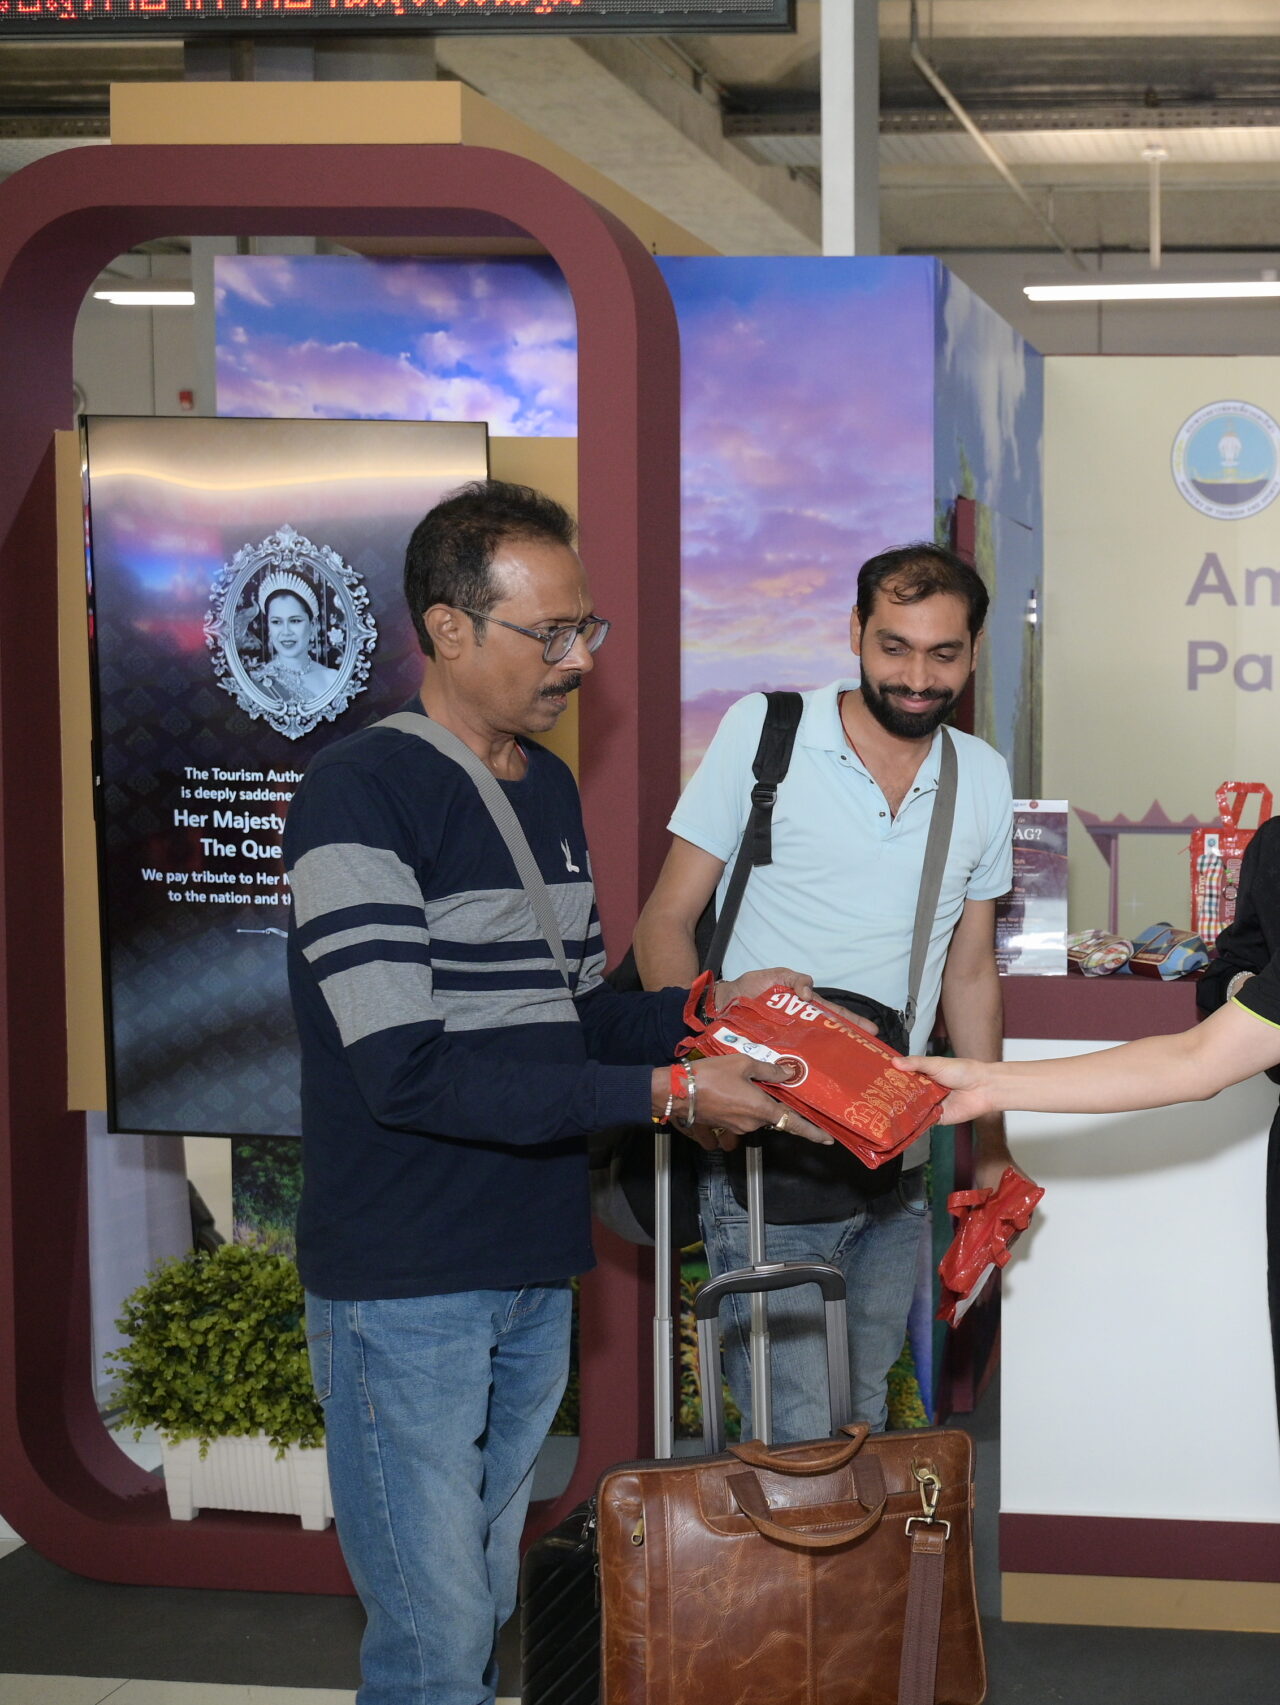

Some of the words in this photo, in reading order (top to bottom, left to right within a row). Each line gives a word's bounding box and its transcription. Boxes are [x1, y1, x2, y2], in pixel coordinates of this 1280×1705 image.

[184, 767, 209, 781] The
[211, 767, 264, 782] Tourism
[181, 786, 192, 799] is
[194, 787, 237, 803] deeply
[239, 788, 295, 802] saddene
[174, 809, 209, 827] Her
[213, 810, 286, 835] Majesty
[1013, 828, 1042, 840] AG?
[200, 838, 237, 857] The
[241, 839, 283, 860] Que
[141, 868, 163, 881] We
[166, 872, 189, 884] pay
[192, 871, 237, 884] tribute
[239, 873, 254, 885] to
[256, 872, 280, 886] Her
[168, 890, 182, 902] to
[184, 890, 207, 903] the
[209, 892, 251, 904] nation
[254, 893, 279, 905] and
[766, 992, 824, 1022] BAG
